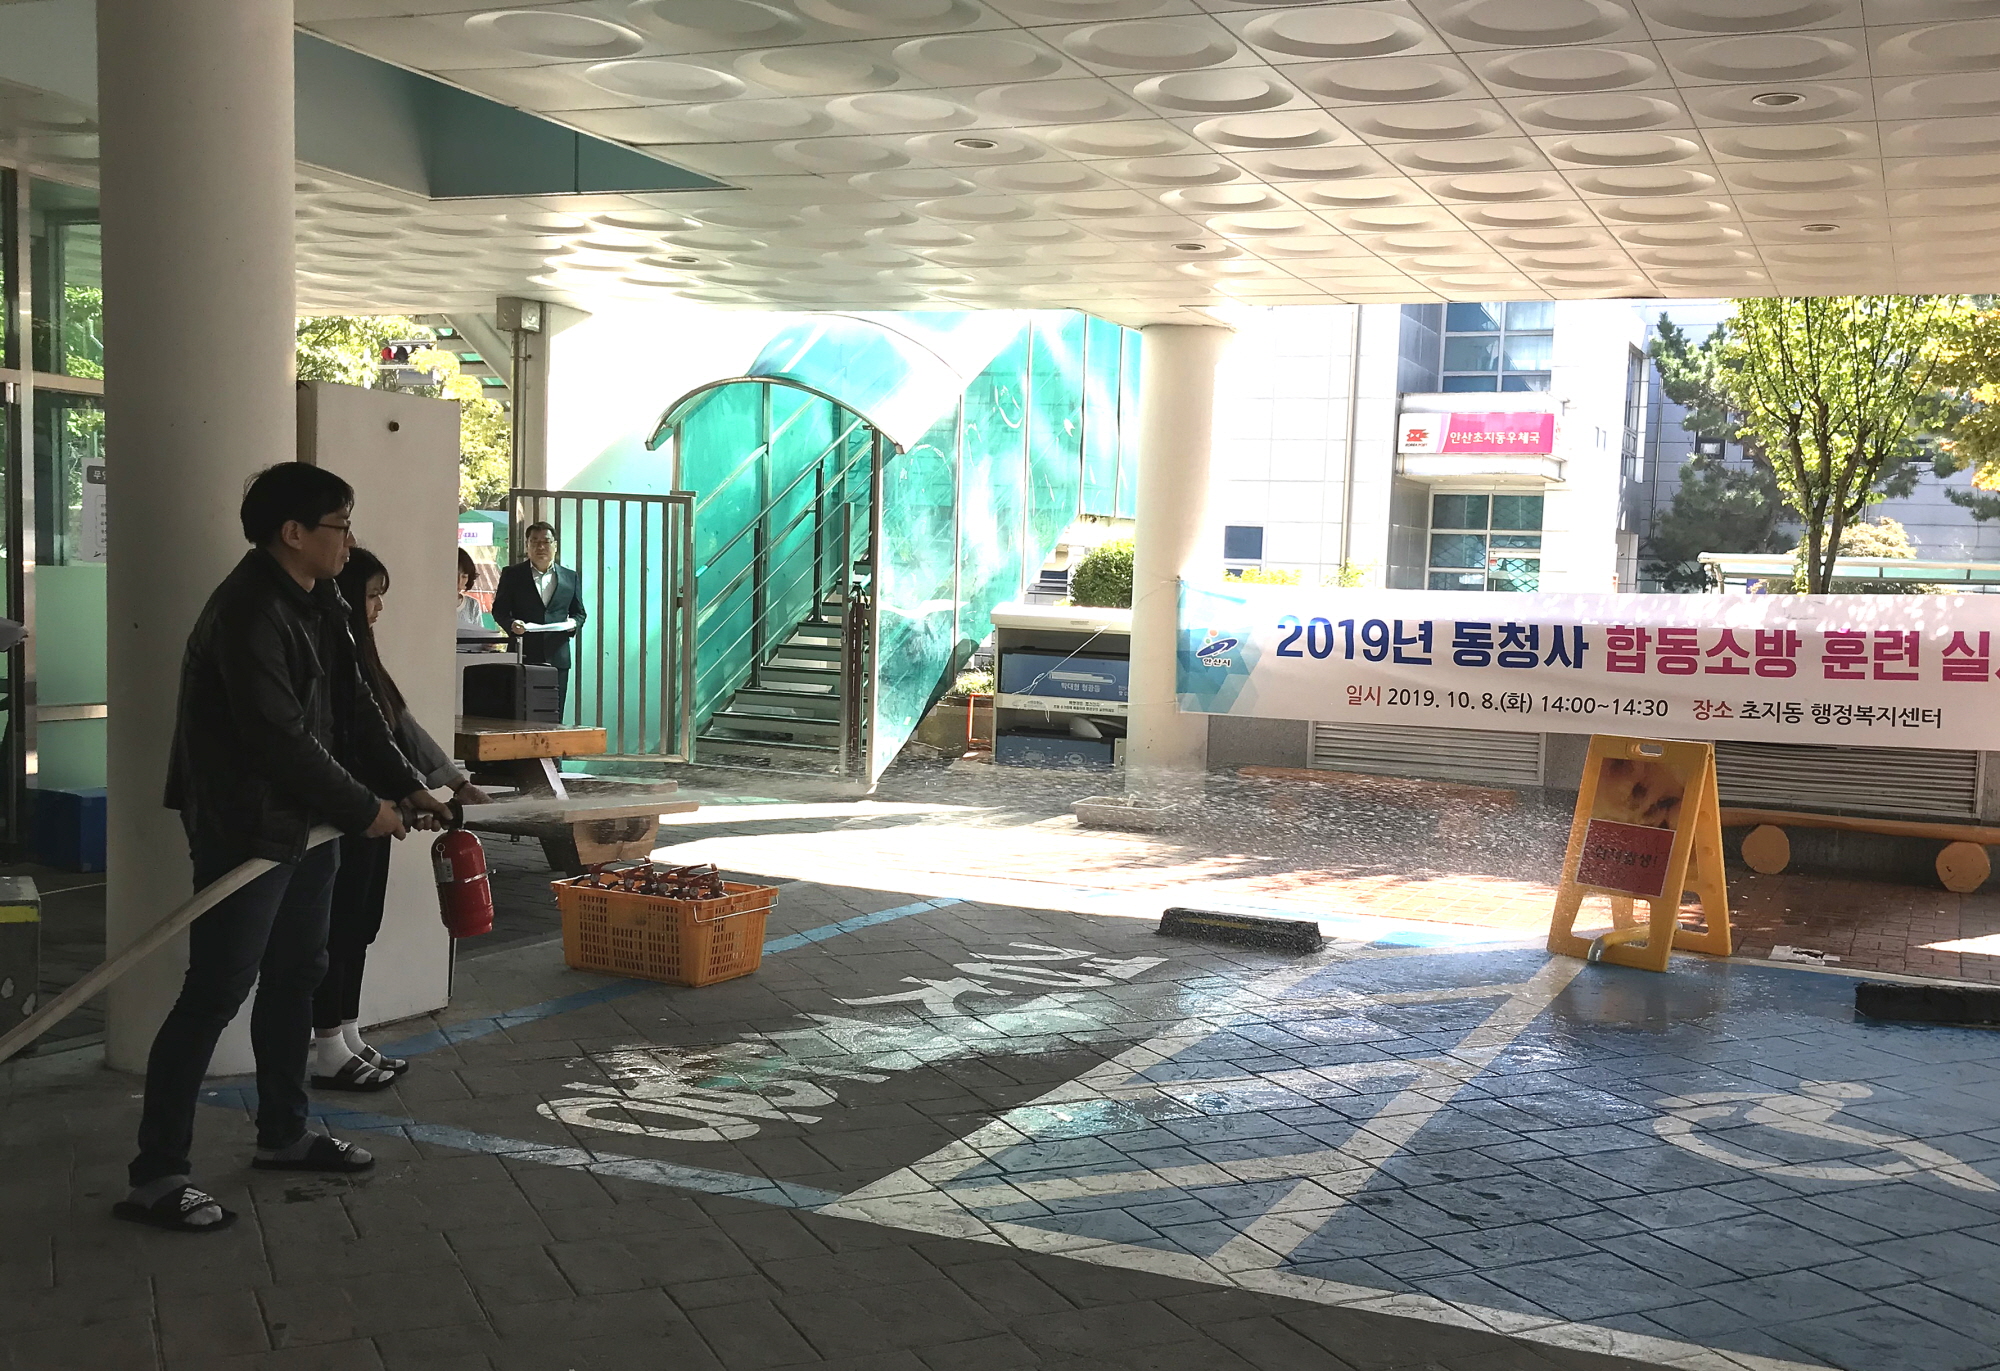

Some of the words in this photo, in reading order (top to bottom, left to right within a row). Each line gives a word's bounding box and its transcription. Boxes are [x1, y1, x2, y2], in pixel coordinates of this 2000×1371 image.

[1450, 431, 1541, 445] 안산초지동우체국
[1203, 658, 1231, 667] 안산시
[1276, 615, 1433, 666] 2019년
[1452, 621, 1589, 669] 동청사
[1606, 625, 1803, 678] 합동소방
[1821, 628, 1920, 681] 훈련
[1941, 631, 2000, 683] 실
[1346, 685, 1381, 707] 일시
[1387, 688, 1440, 708] 2019.
[1447, 690, 1475, 710] 10.
[1481, 691, 1533, 714] 8.(화)
[1541, 694, 1669, 717] 14:00~14:30
[1692, 699, 1734, 721] 장소
[1740, 700, 1804, 725] 초지동
[1810, 702, 1942, 729] 행정복지센터
